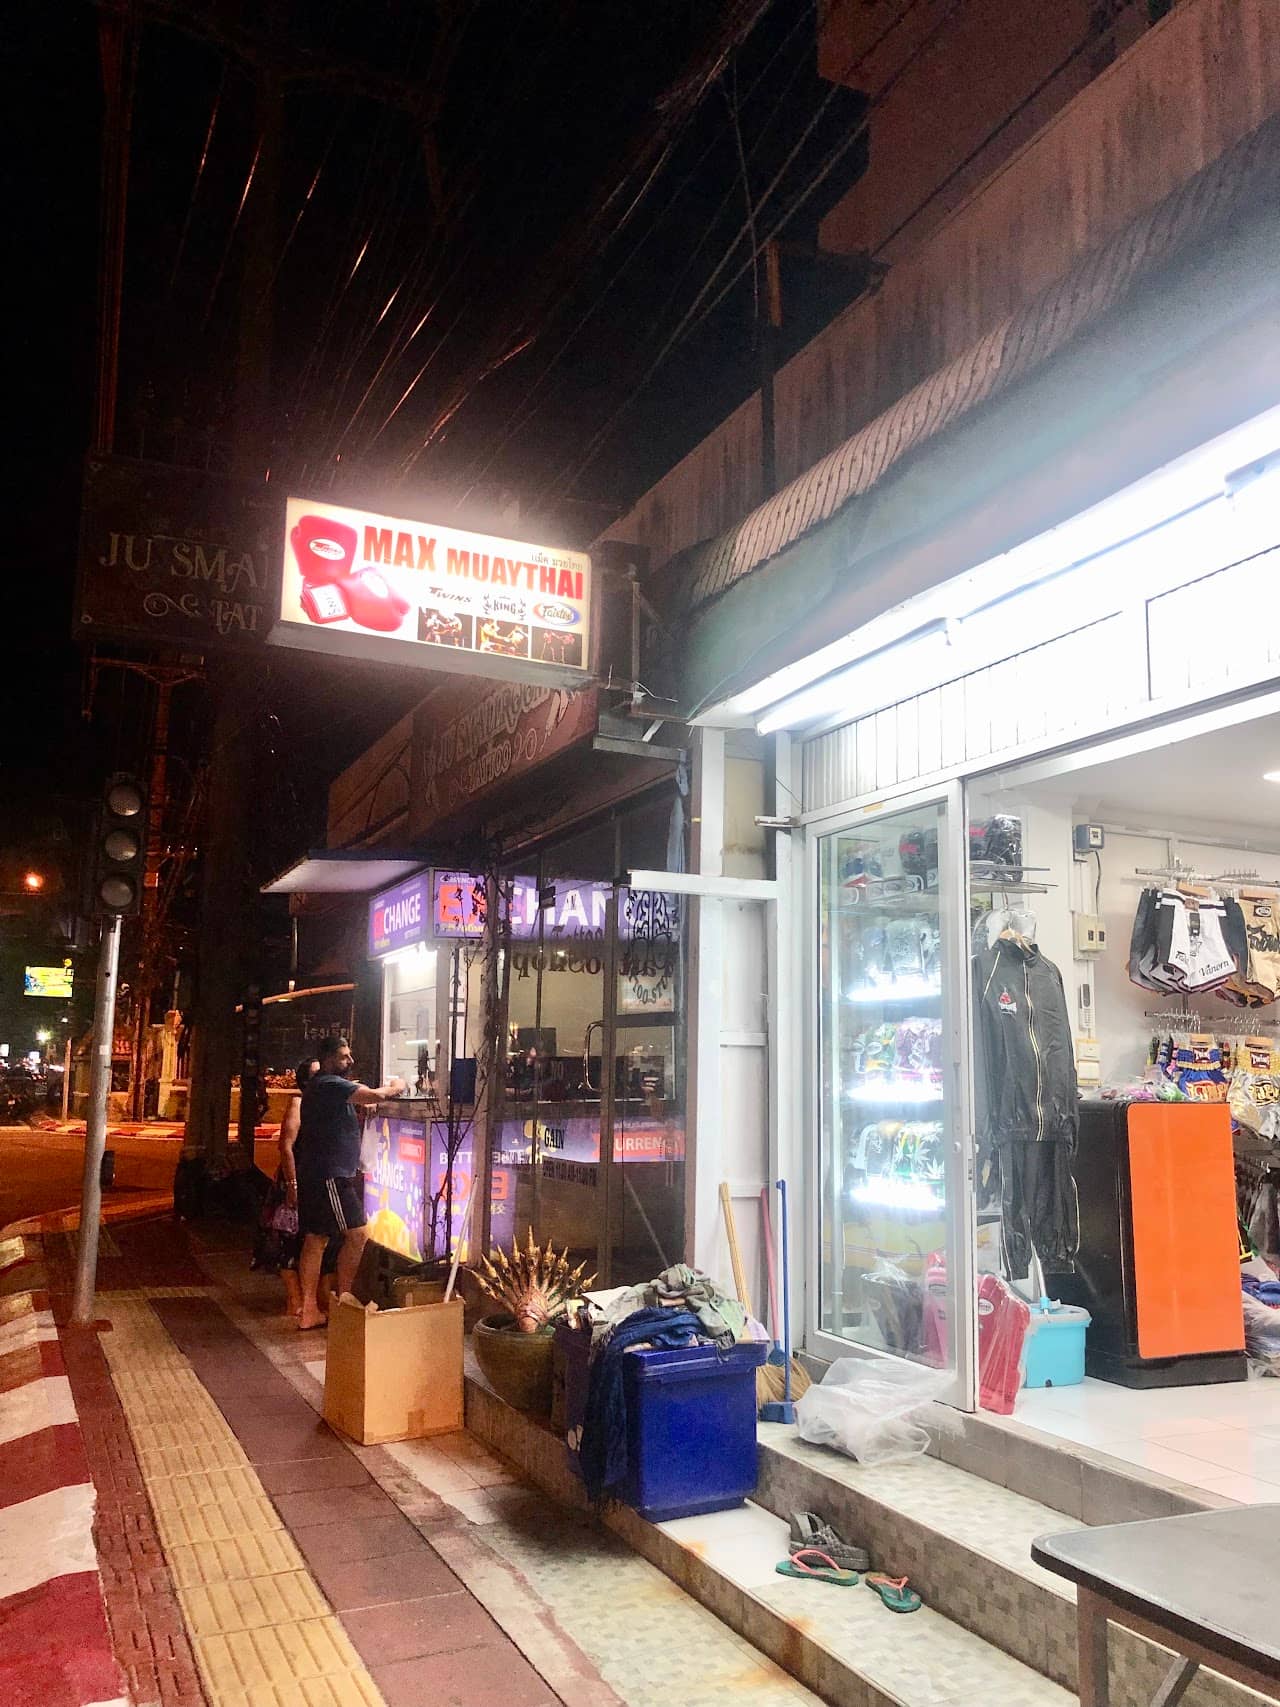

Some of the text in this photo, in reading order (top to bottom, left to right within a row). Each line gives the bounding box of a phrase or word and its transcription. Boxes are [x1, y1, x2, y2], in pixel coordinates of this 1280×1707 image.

[363, 525, 583, 600] MAX MUAYTHAI
[493, 599, 517, 615] KING
